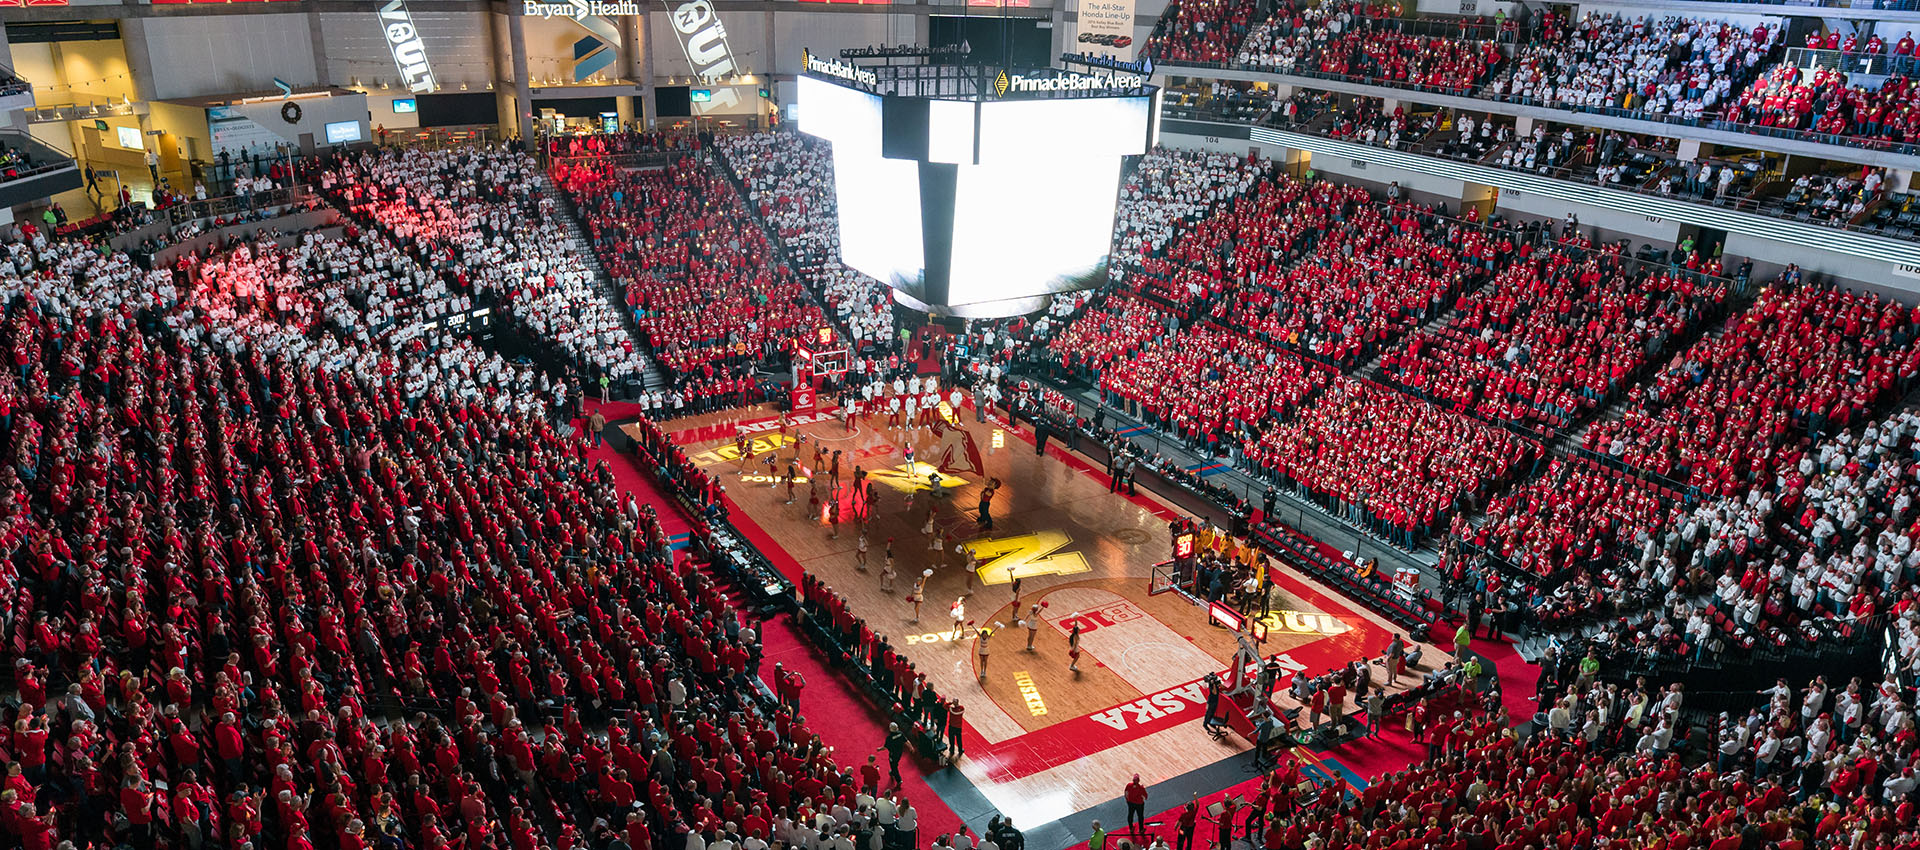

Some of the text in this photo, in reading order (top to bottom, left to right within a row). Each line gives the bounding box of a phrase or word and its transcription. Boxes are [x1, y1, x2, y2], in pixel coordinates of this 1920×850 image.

[523, 0, 639, 20] Bryan Health
[1461, 3, 1476, 11] 203
[1105, 12, 1131, 20] Line-Up
[1104, 73, 1142, 89] Arena
[741, 475, 808, 484] POWR
[1179, 542, 1191, 556] 30
[961, 528, 1093, 586] N
[1013, 671, 1048, 717] HUSKER
